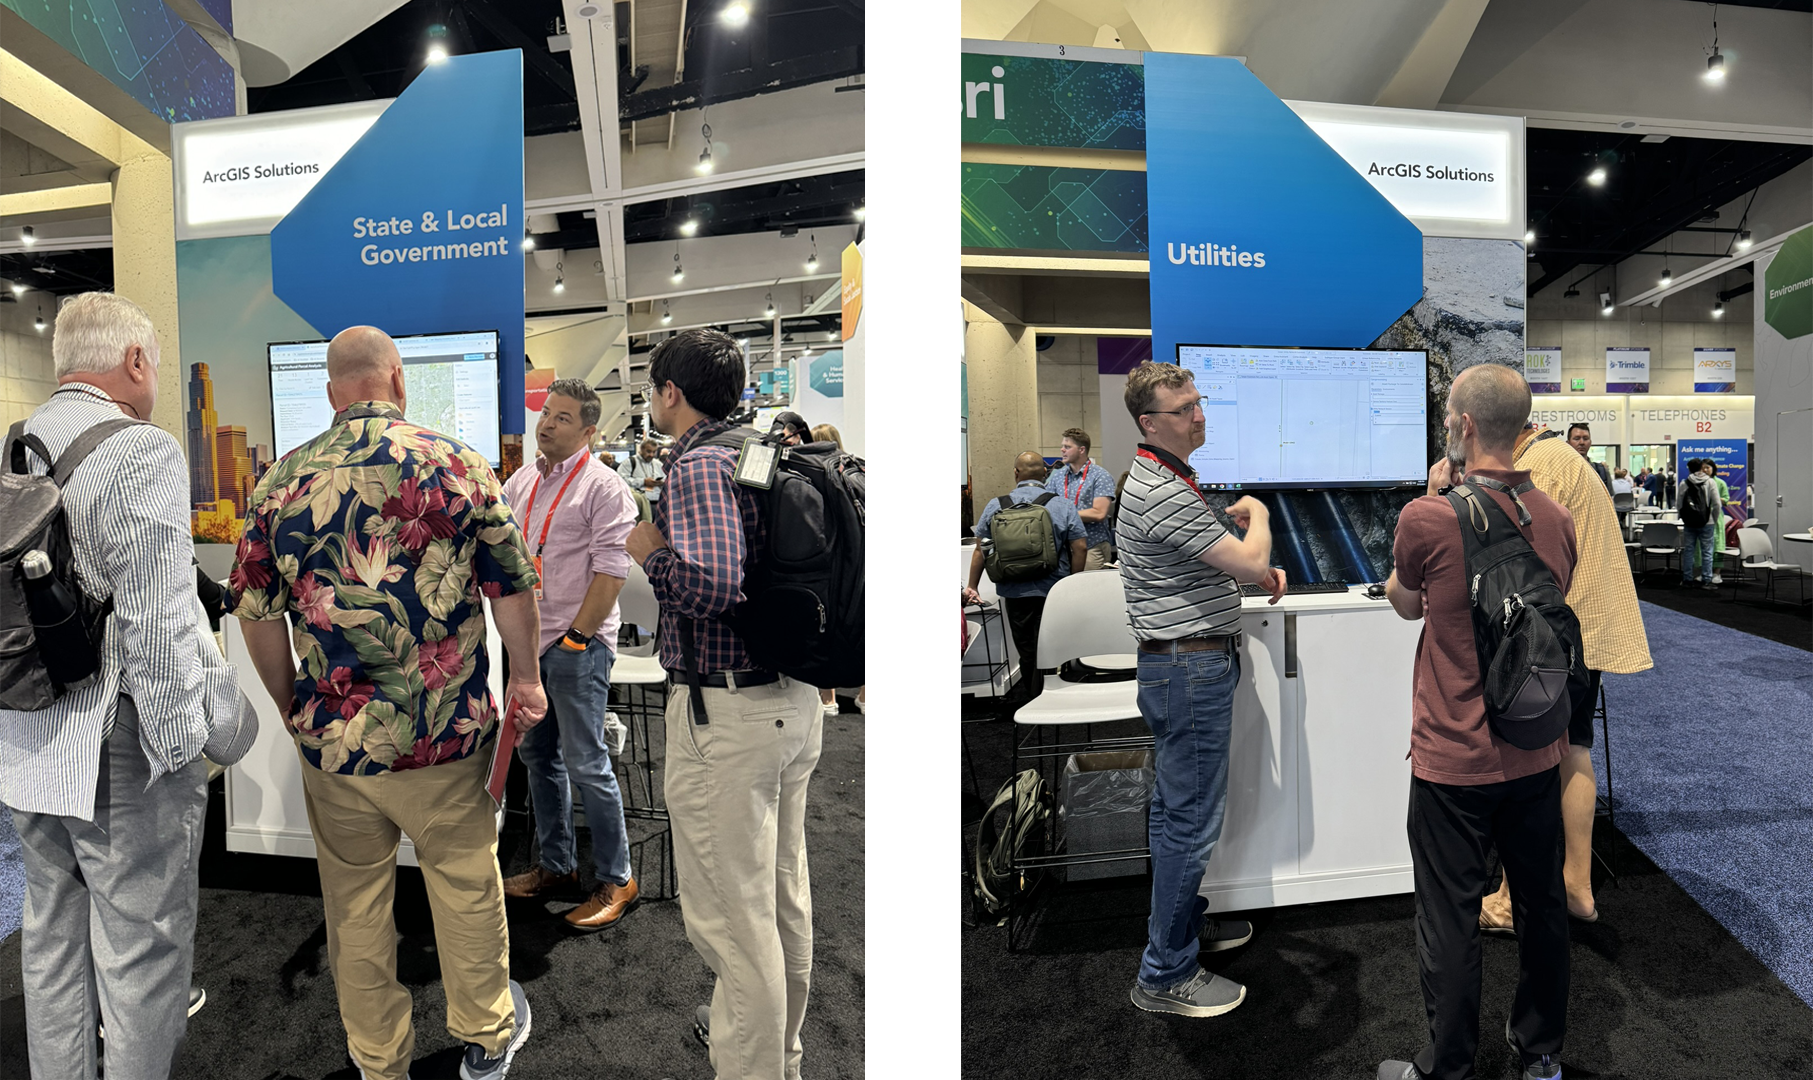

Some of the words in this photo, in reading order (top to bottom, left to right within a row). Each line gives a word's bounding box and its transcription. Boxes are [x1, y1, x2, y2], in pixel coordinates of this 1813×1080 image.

[1059, 45, 1065, 56] 3
[961, 65, 1005, 120] ri
[203, 168, 250, 184] ArcGIS
[254, 162, 319, 179] Solutions
[1368, 162, 1422, 178] ArcGIS
[1426, 165, 1495, 182] Solutions
[353, 216, 413, 238] State
[421, 211, 440, 233] &
[447, 203, 508, 231] Local
[360, 236, 509, 266] Government
[1167, 242, 1266, 268] Utilities
[1526, 354, 1546, 368] ROK
[1617, 361, 1645, 369] Trimble
[1532, 410, 1617, 422] RESTROOMS
[1640, 409, 1727, 421] TELEPHONES
[1696, 421, 1712, 433] B2
